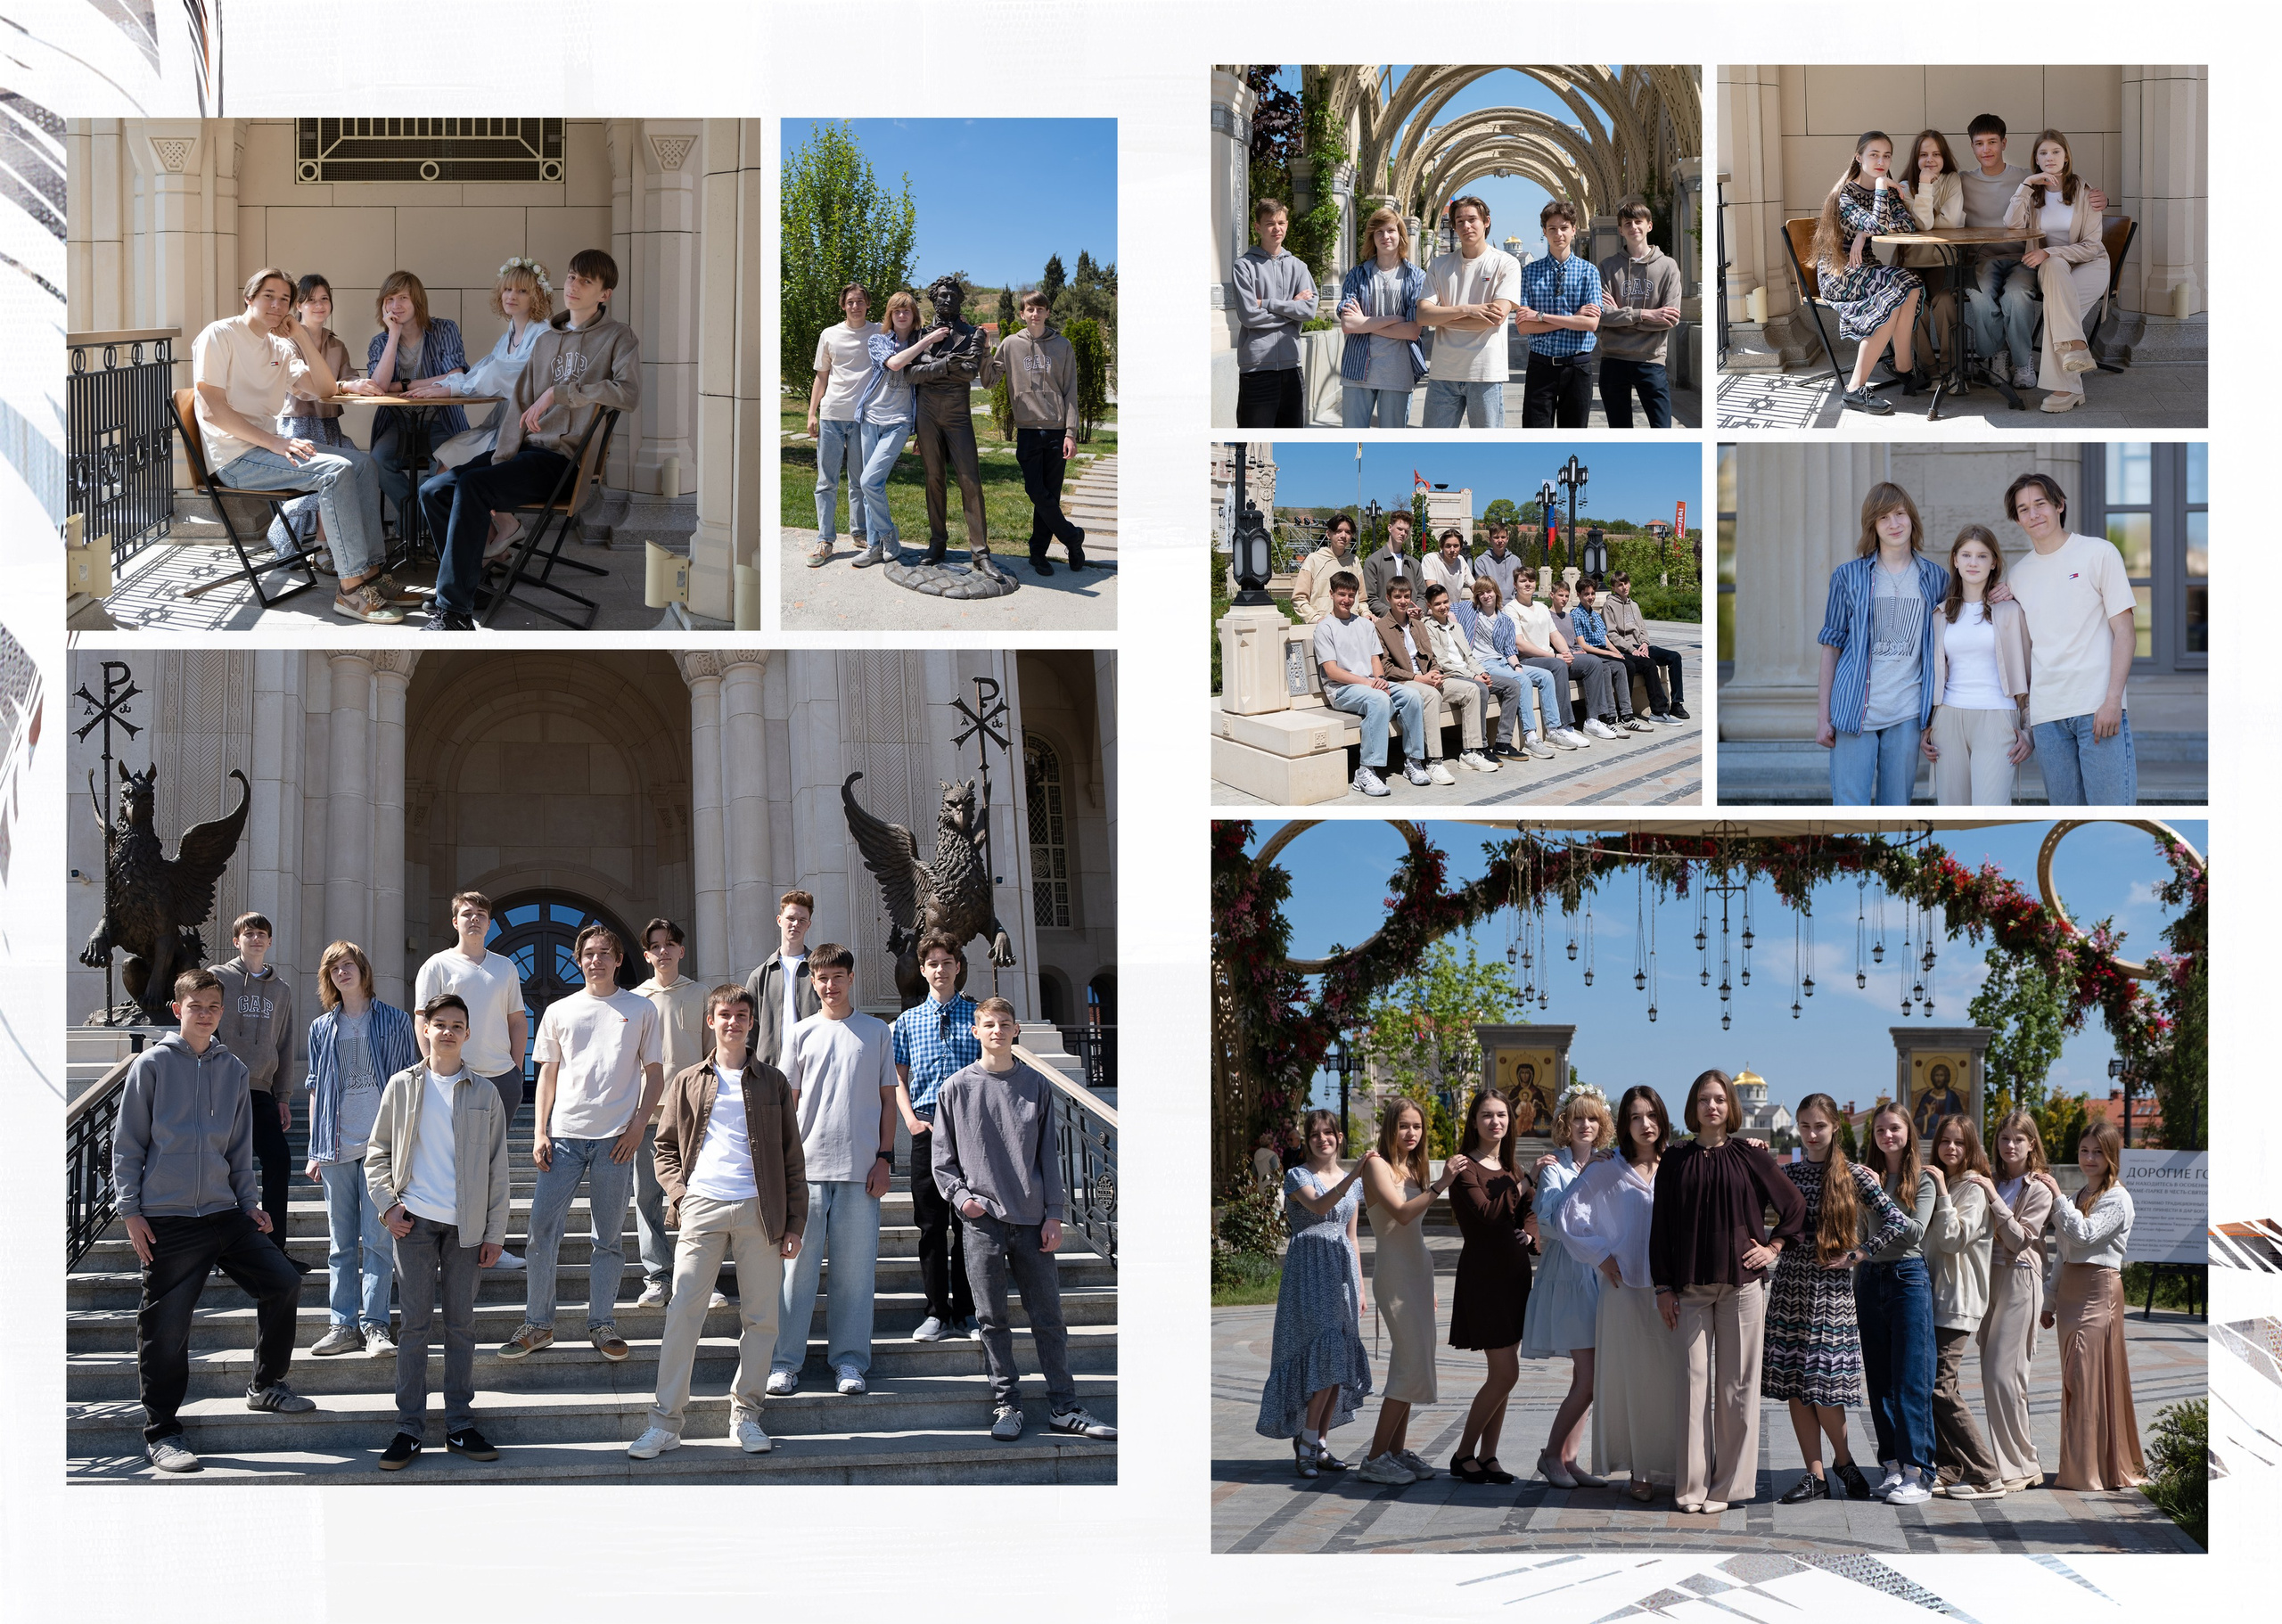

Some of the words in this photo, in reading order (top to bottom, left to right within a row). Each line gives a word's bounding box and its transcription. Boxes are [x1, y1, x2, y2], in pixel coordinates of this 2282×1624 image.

[1621, 278, 1654, 298] GAP
[550, 351, 588, 381] GAP
[1022, 354, 1052, 374] GAP
[237, 995, 274, 1016] GAP
[2126, 1167, 2192, 1179] ДОРОГИЕ
